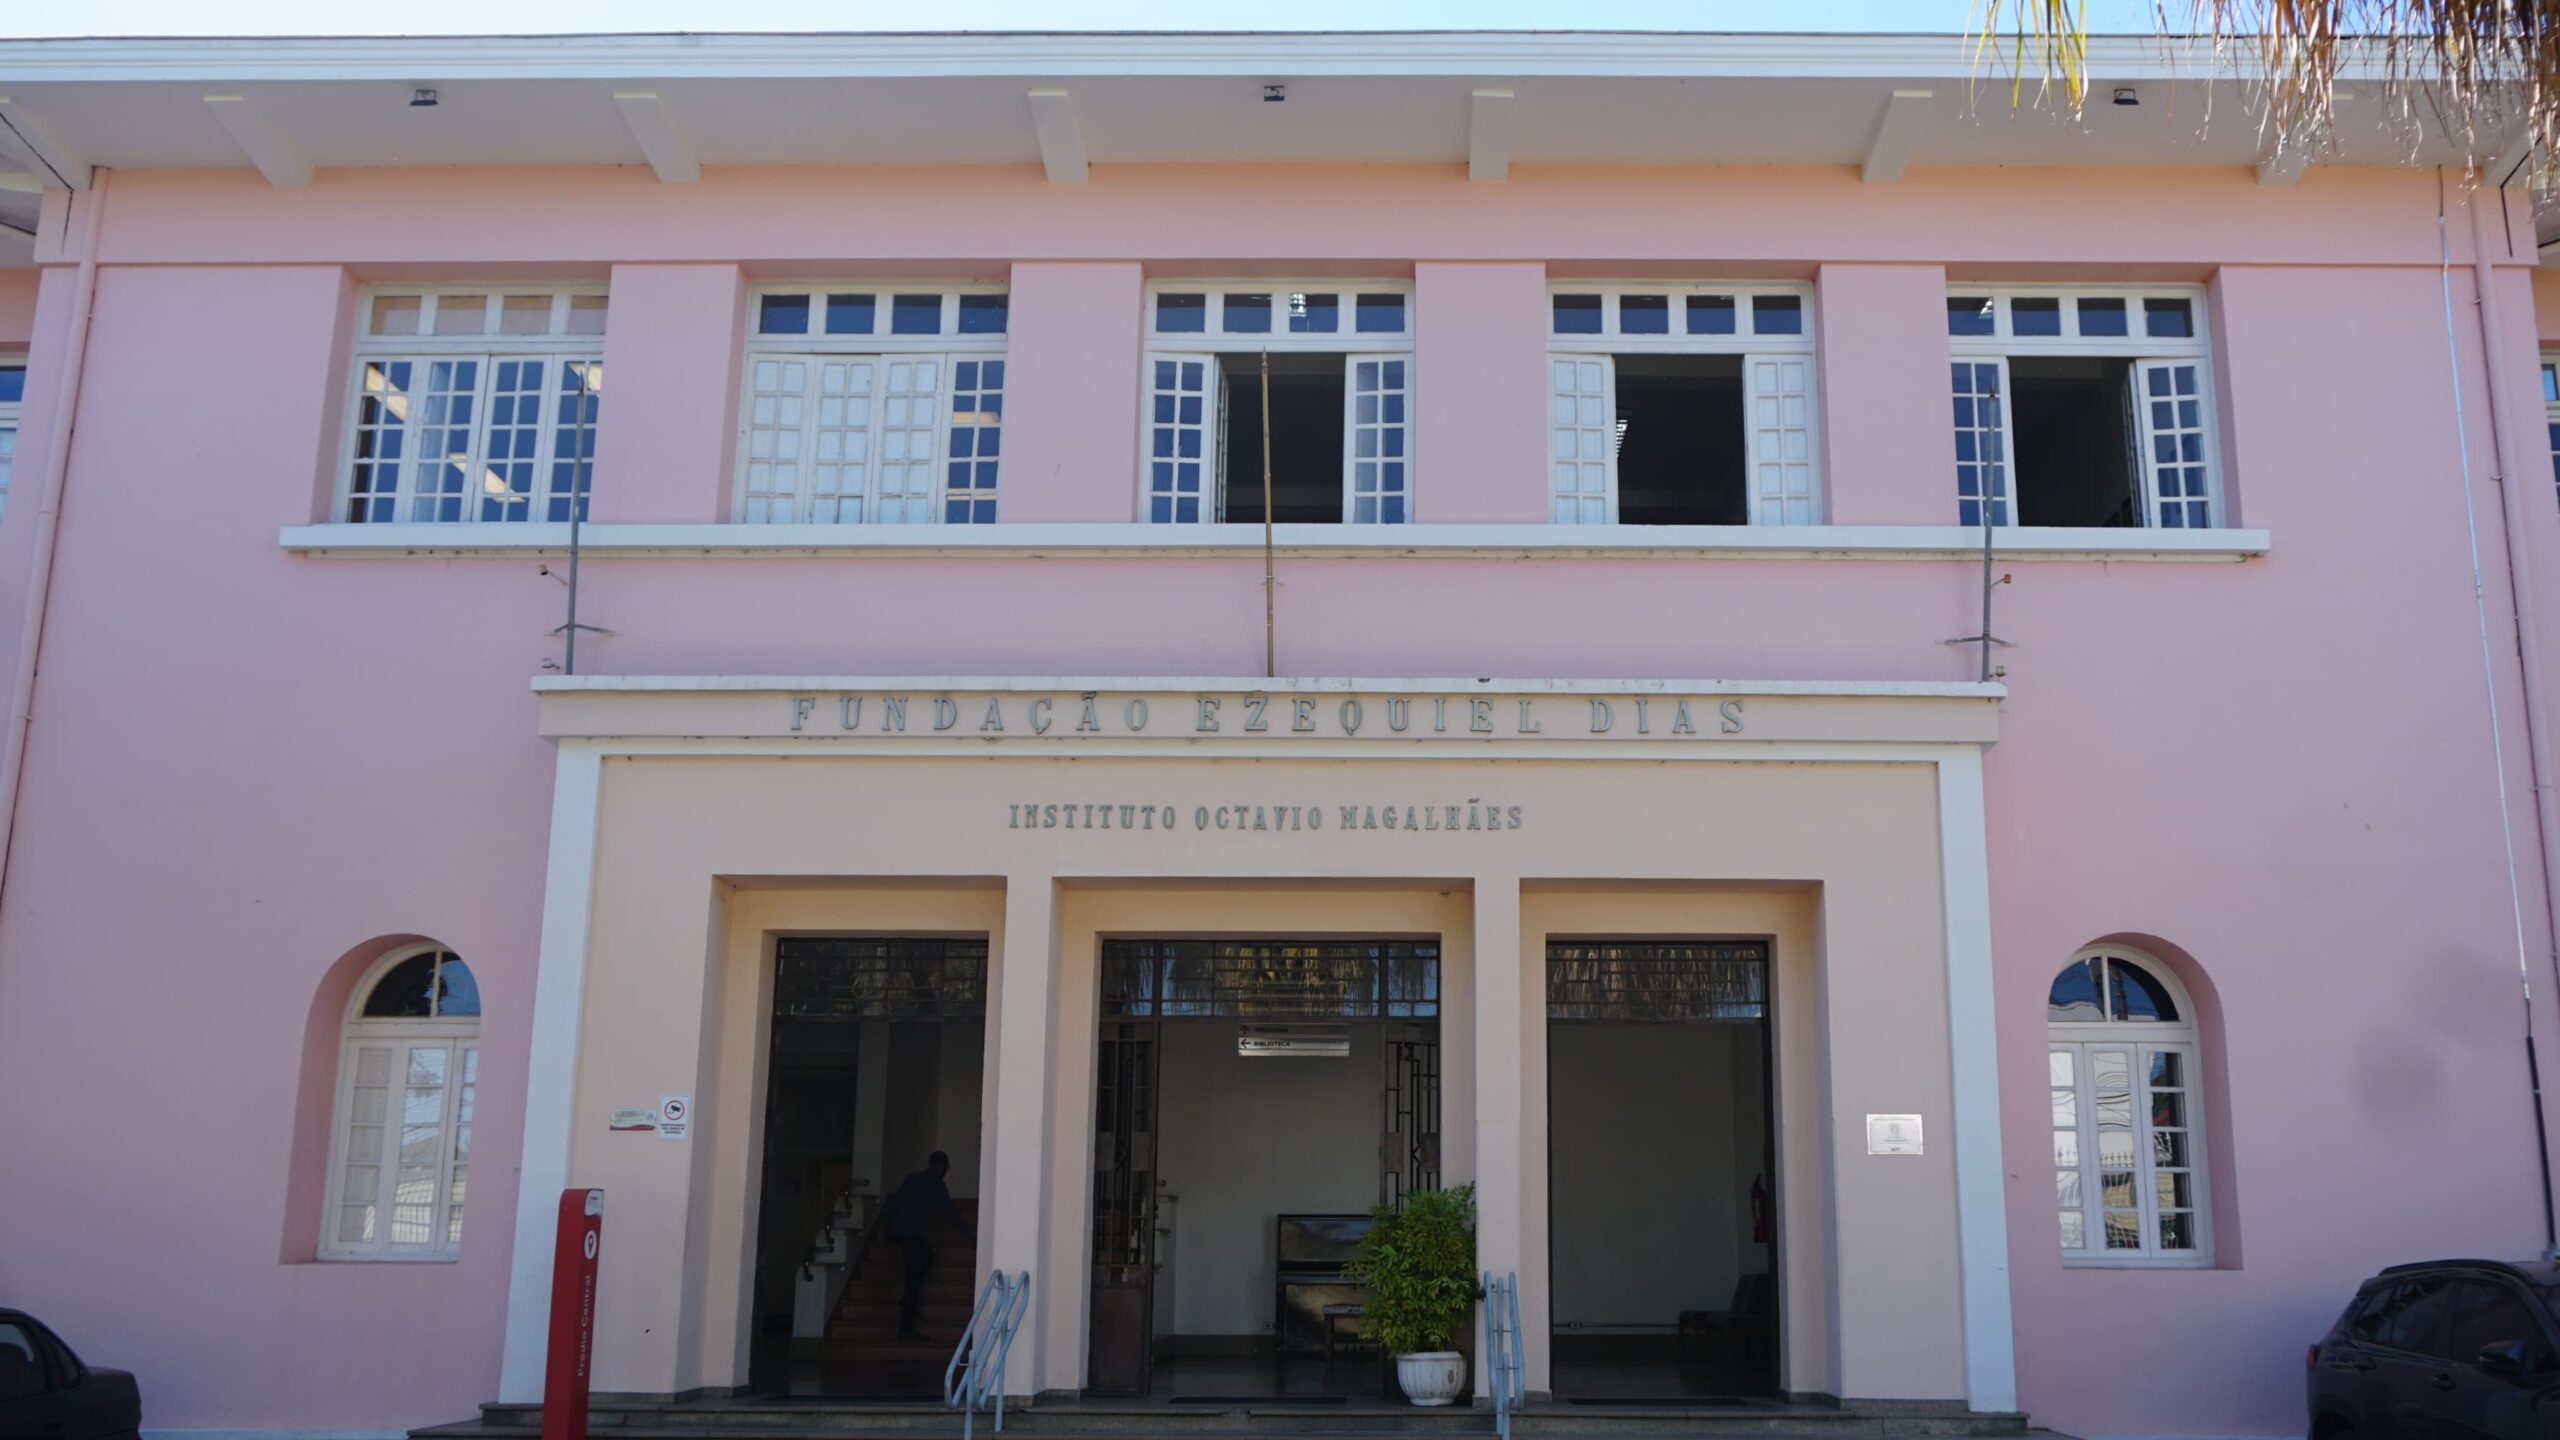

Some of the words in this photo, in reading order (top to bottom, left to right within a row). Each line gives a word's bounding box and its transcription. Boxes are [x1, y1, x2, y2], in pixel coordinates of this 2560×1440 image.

[791, 691, 1149, 734] FUNDAÇÃO
[1196, 697, 1541, 735] EZEQUIEL
[1591, 699, 1745, 734] DIAS
[1008, 804, 1176, 830] INSTITUTO
[1194, 804, 1323, 831] OCTAVIO
[1339, 797, 1523, 831] MAGALHÃES
[581, 1274, 591, 1328] Central
